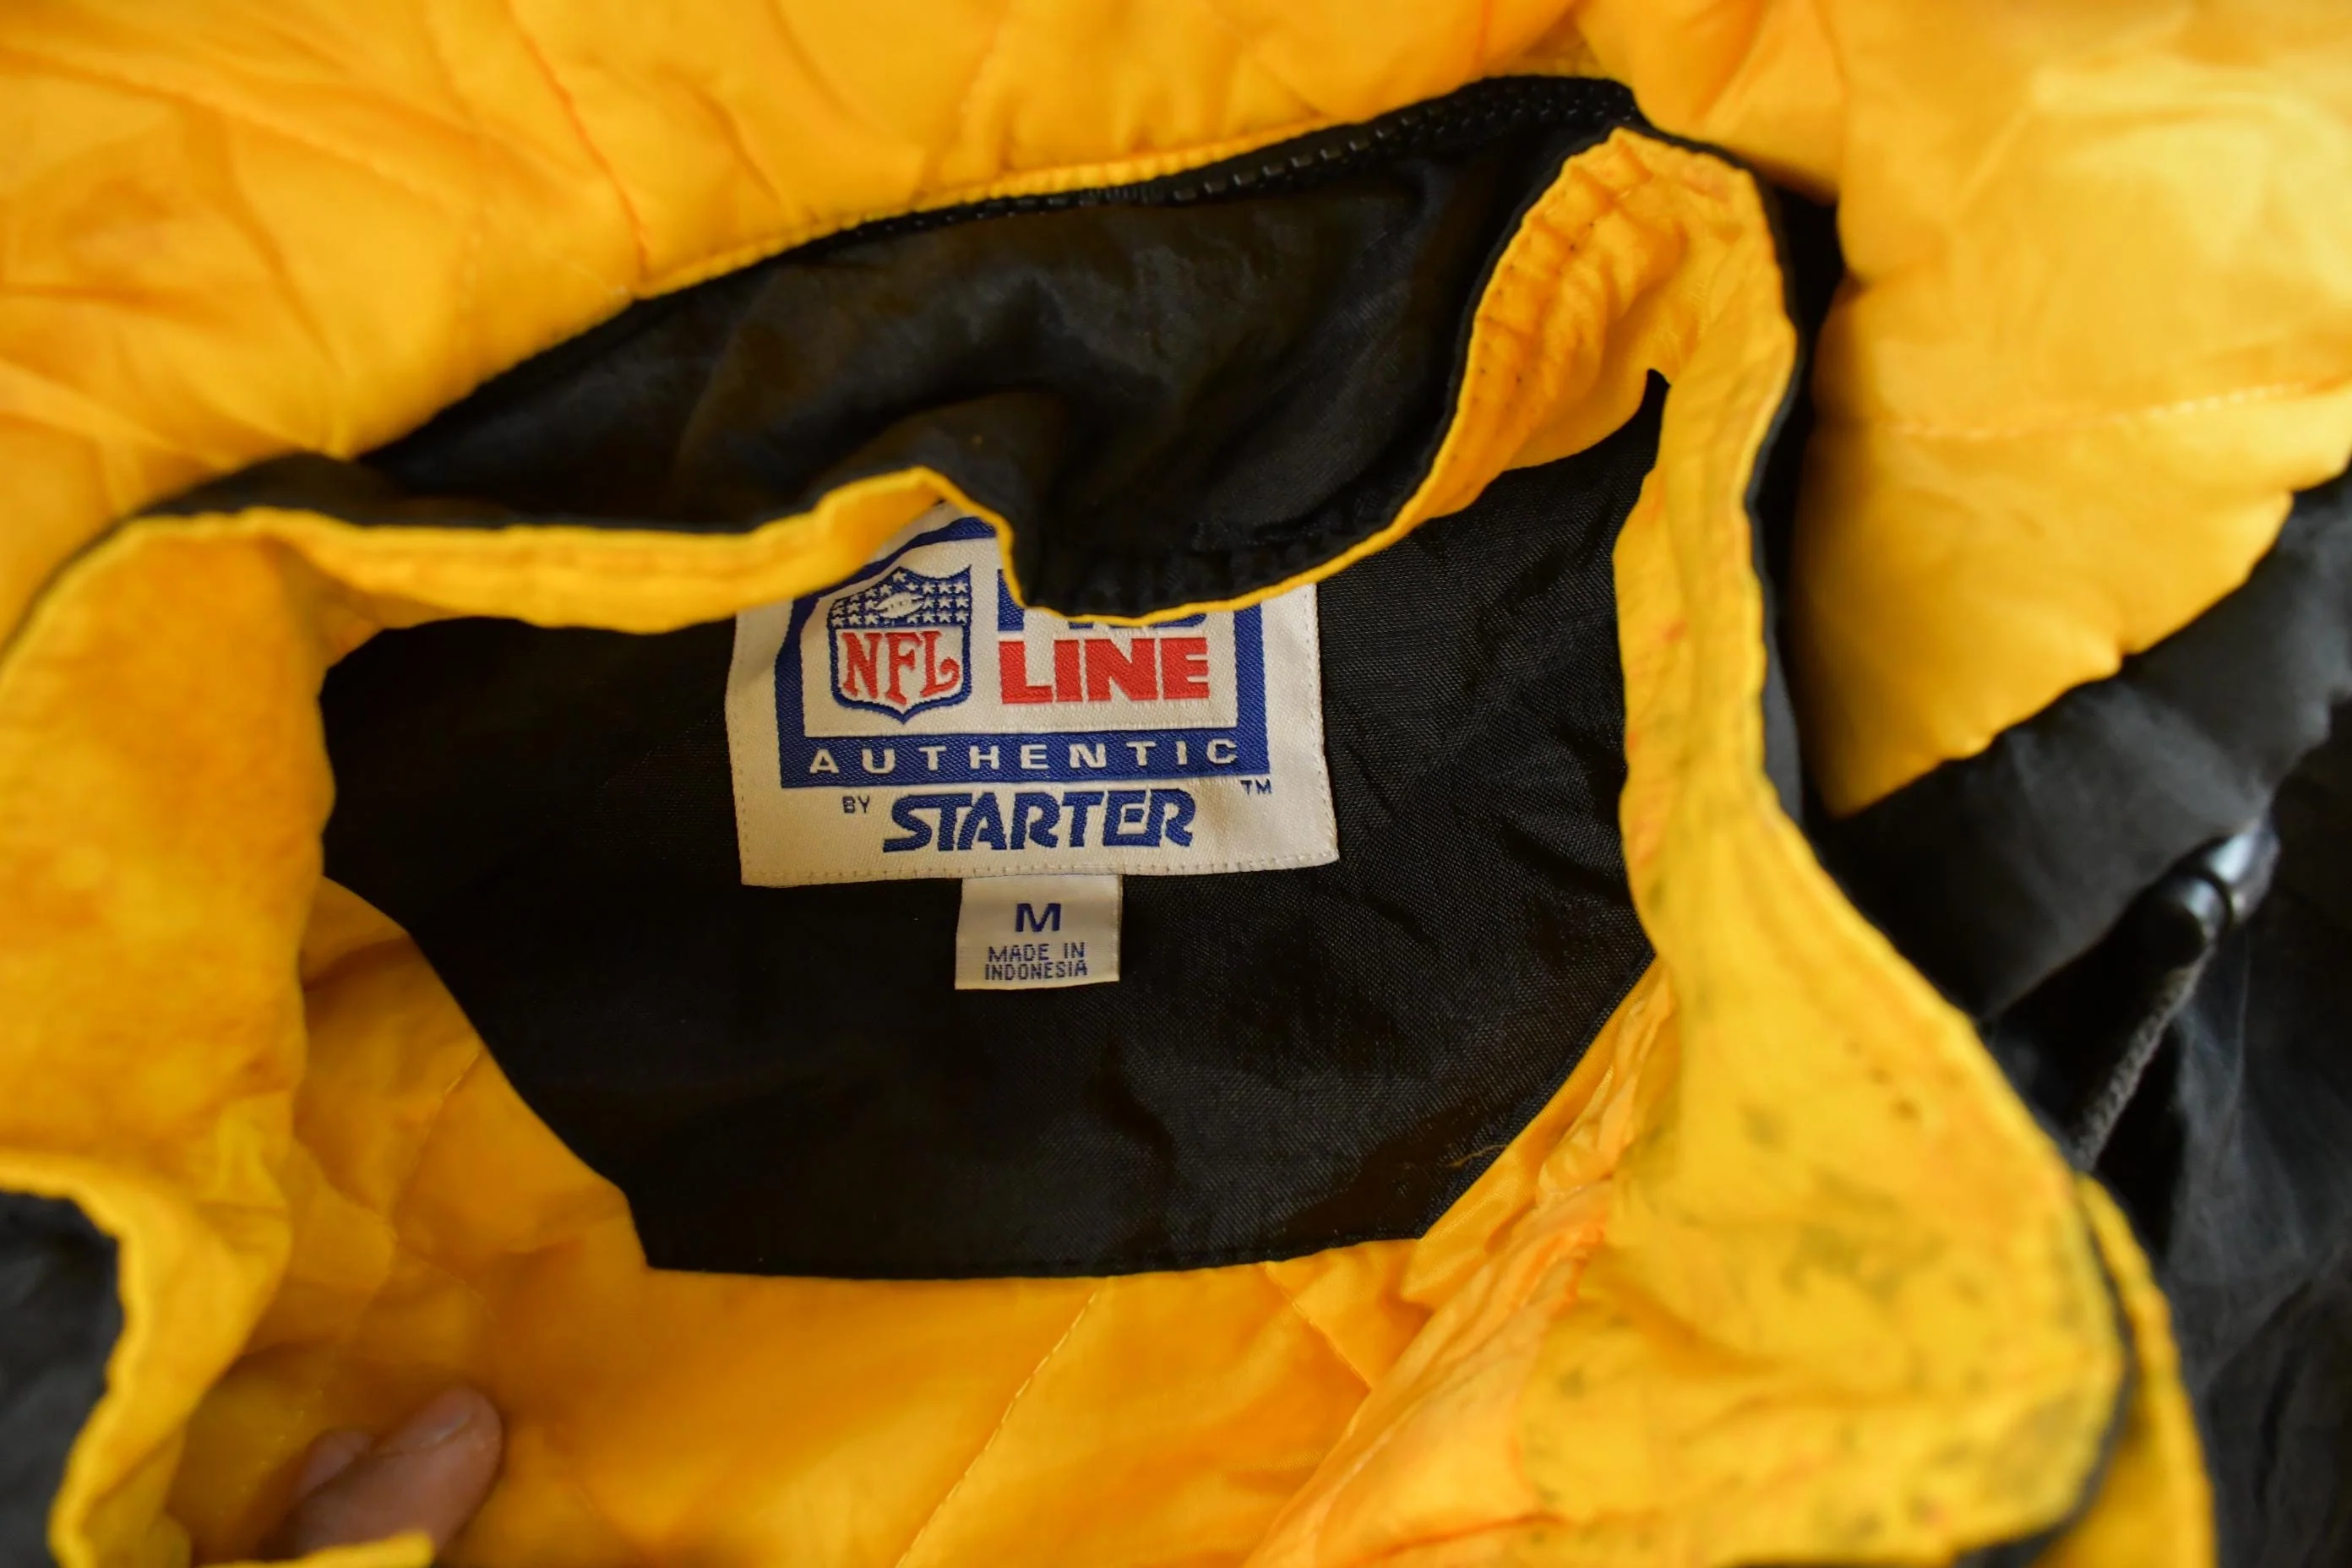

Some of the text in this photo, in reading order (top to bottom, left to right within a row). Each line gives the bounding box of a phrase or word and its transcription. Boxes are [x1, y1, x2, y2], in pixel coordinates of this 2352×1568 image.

[841, 630, 961, 705] NFL
[999, 637, 1210, 705] LINE
[808, 739, 1239, 776] AUTHENTIC
[843, 795, 870, 814] BY
[883, 787, 1197, 852] STARTER
[1015, 903, 1062, 933] M
[988, 941, 1086, 962] MADE IN
[984, 960, 1088, 981] INDONESIA
